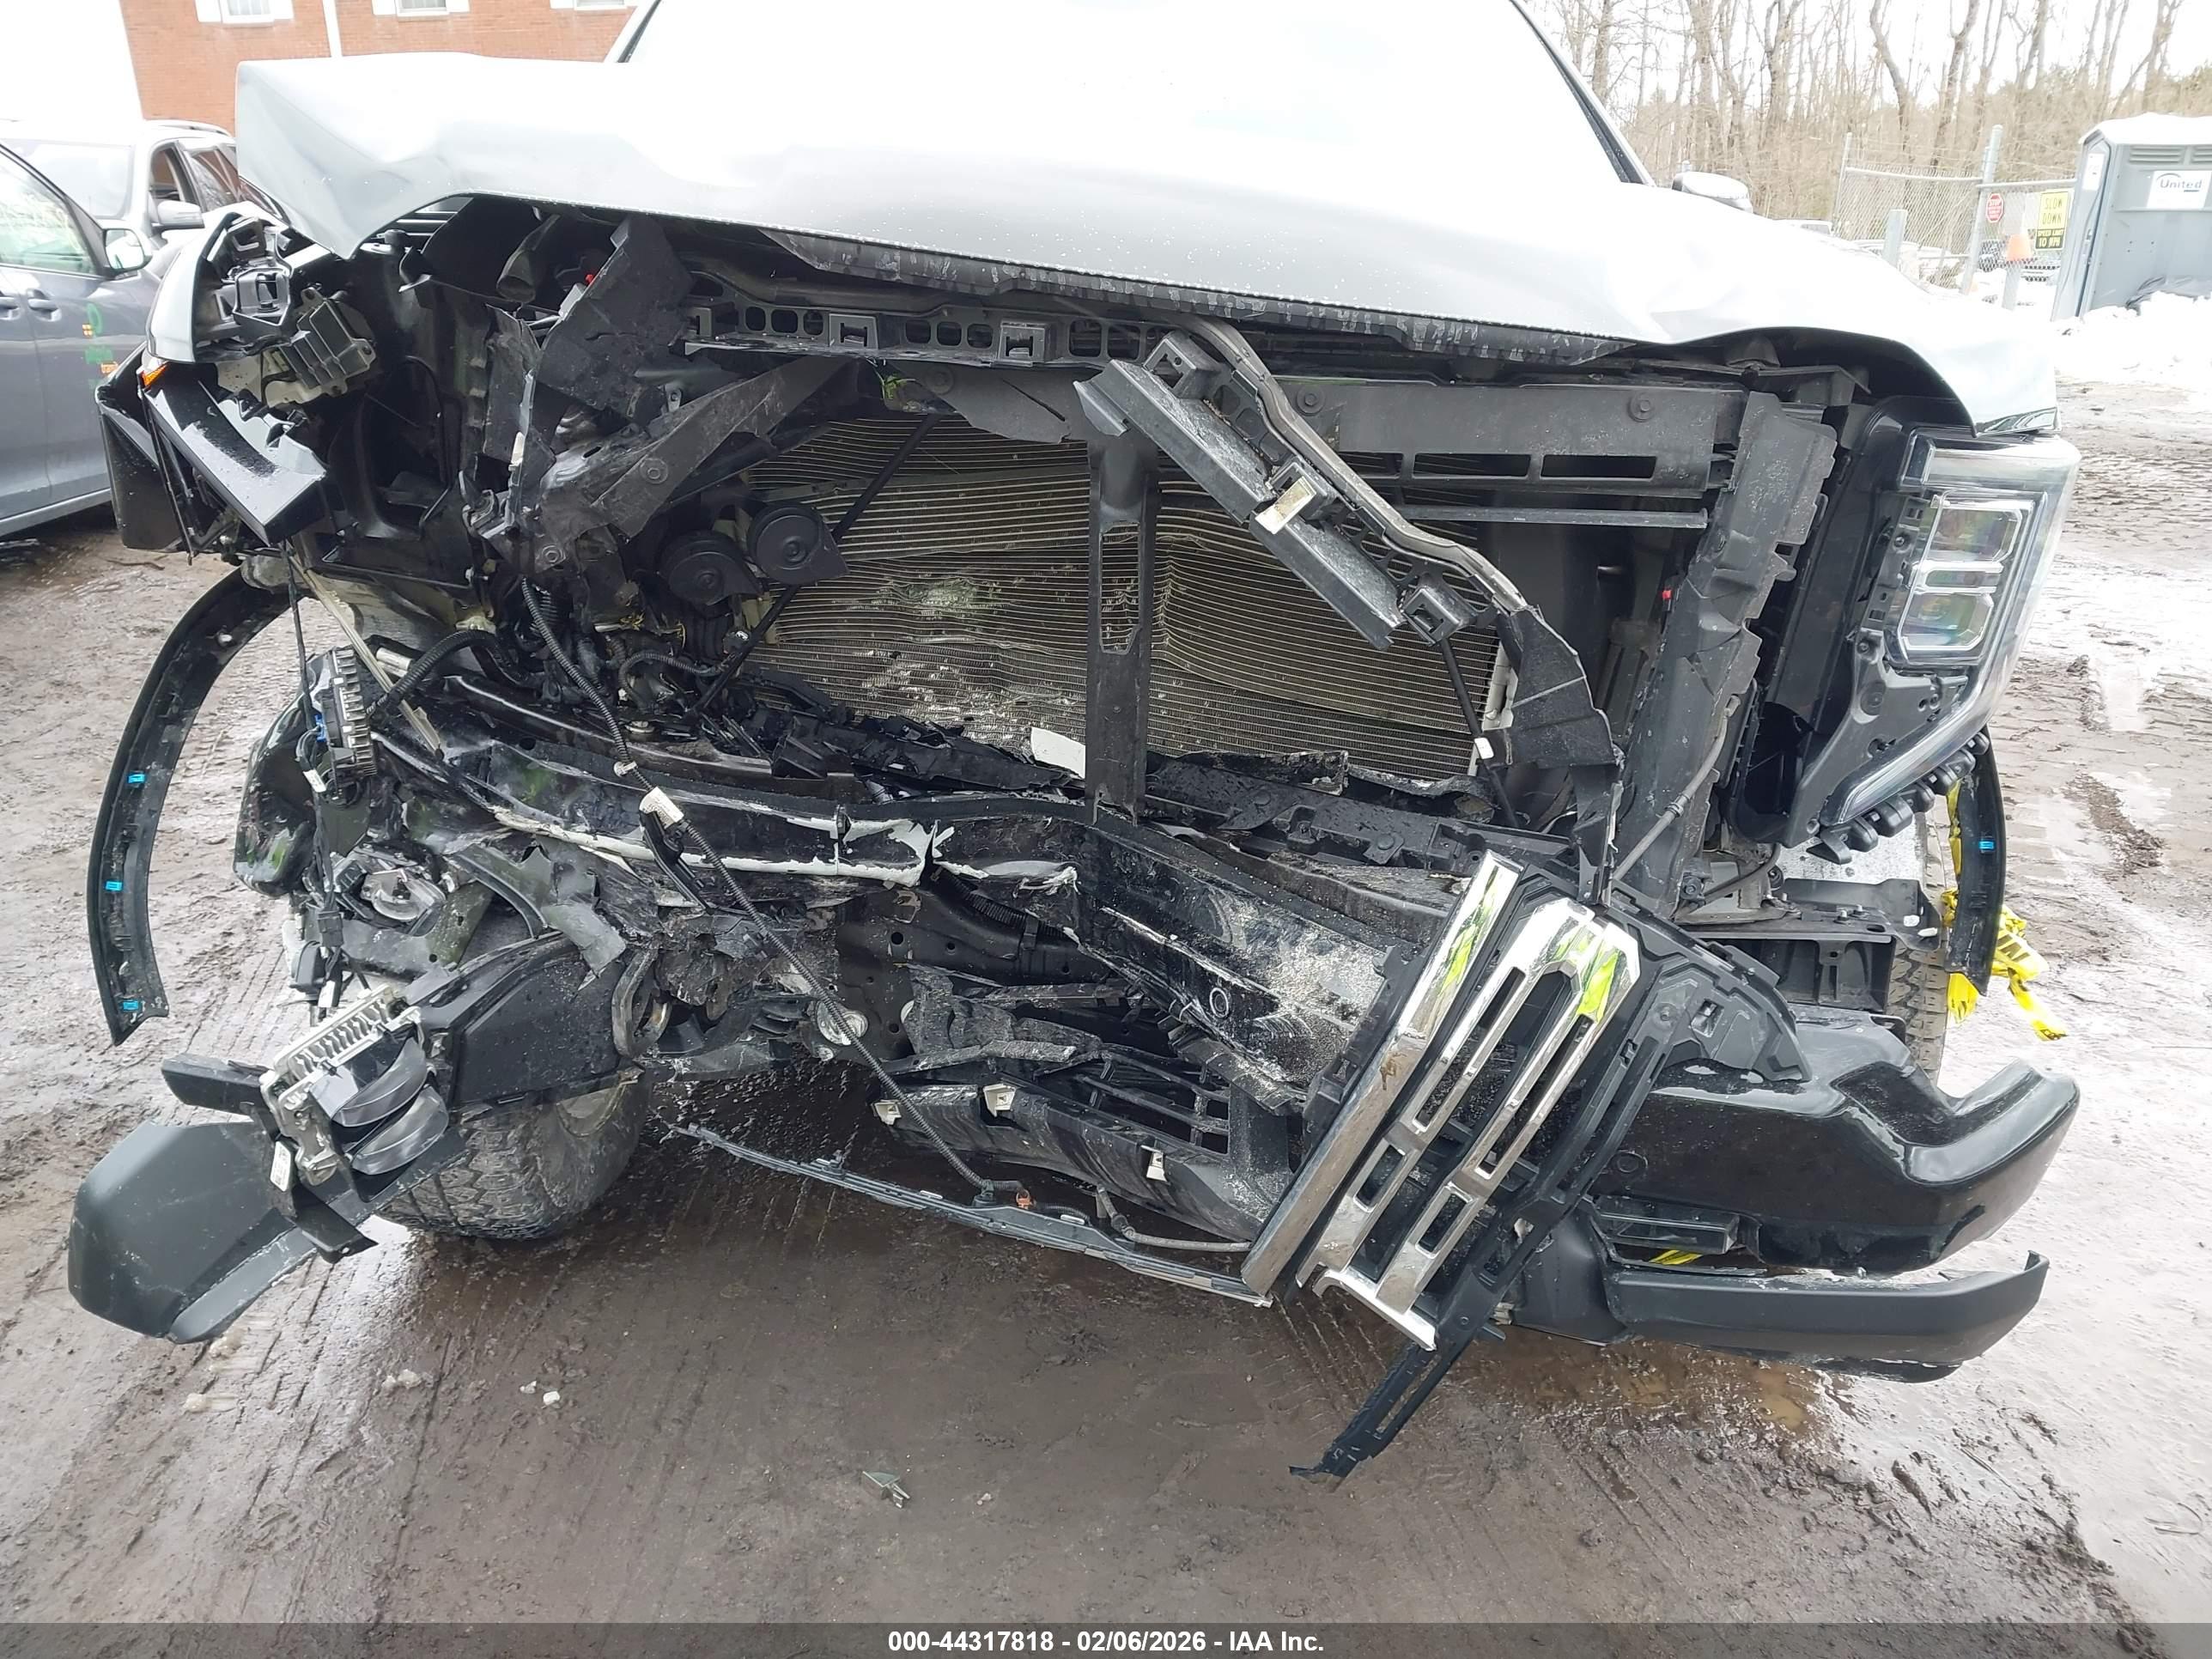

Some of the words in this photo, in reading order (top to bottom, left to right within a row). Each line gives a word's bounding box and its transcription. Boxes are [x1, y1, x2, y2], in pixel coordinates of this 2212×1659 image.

[2160, 179, 2203, 189] United
[1989, 198, 2001, 207] STOP
[2045, 198, 2063, 210] SLOW
[2042, 212, 2062, 225] DOWN
[2039, 237, 2047, 248] 10
[2048, 236, 2061, 247] MPH
